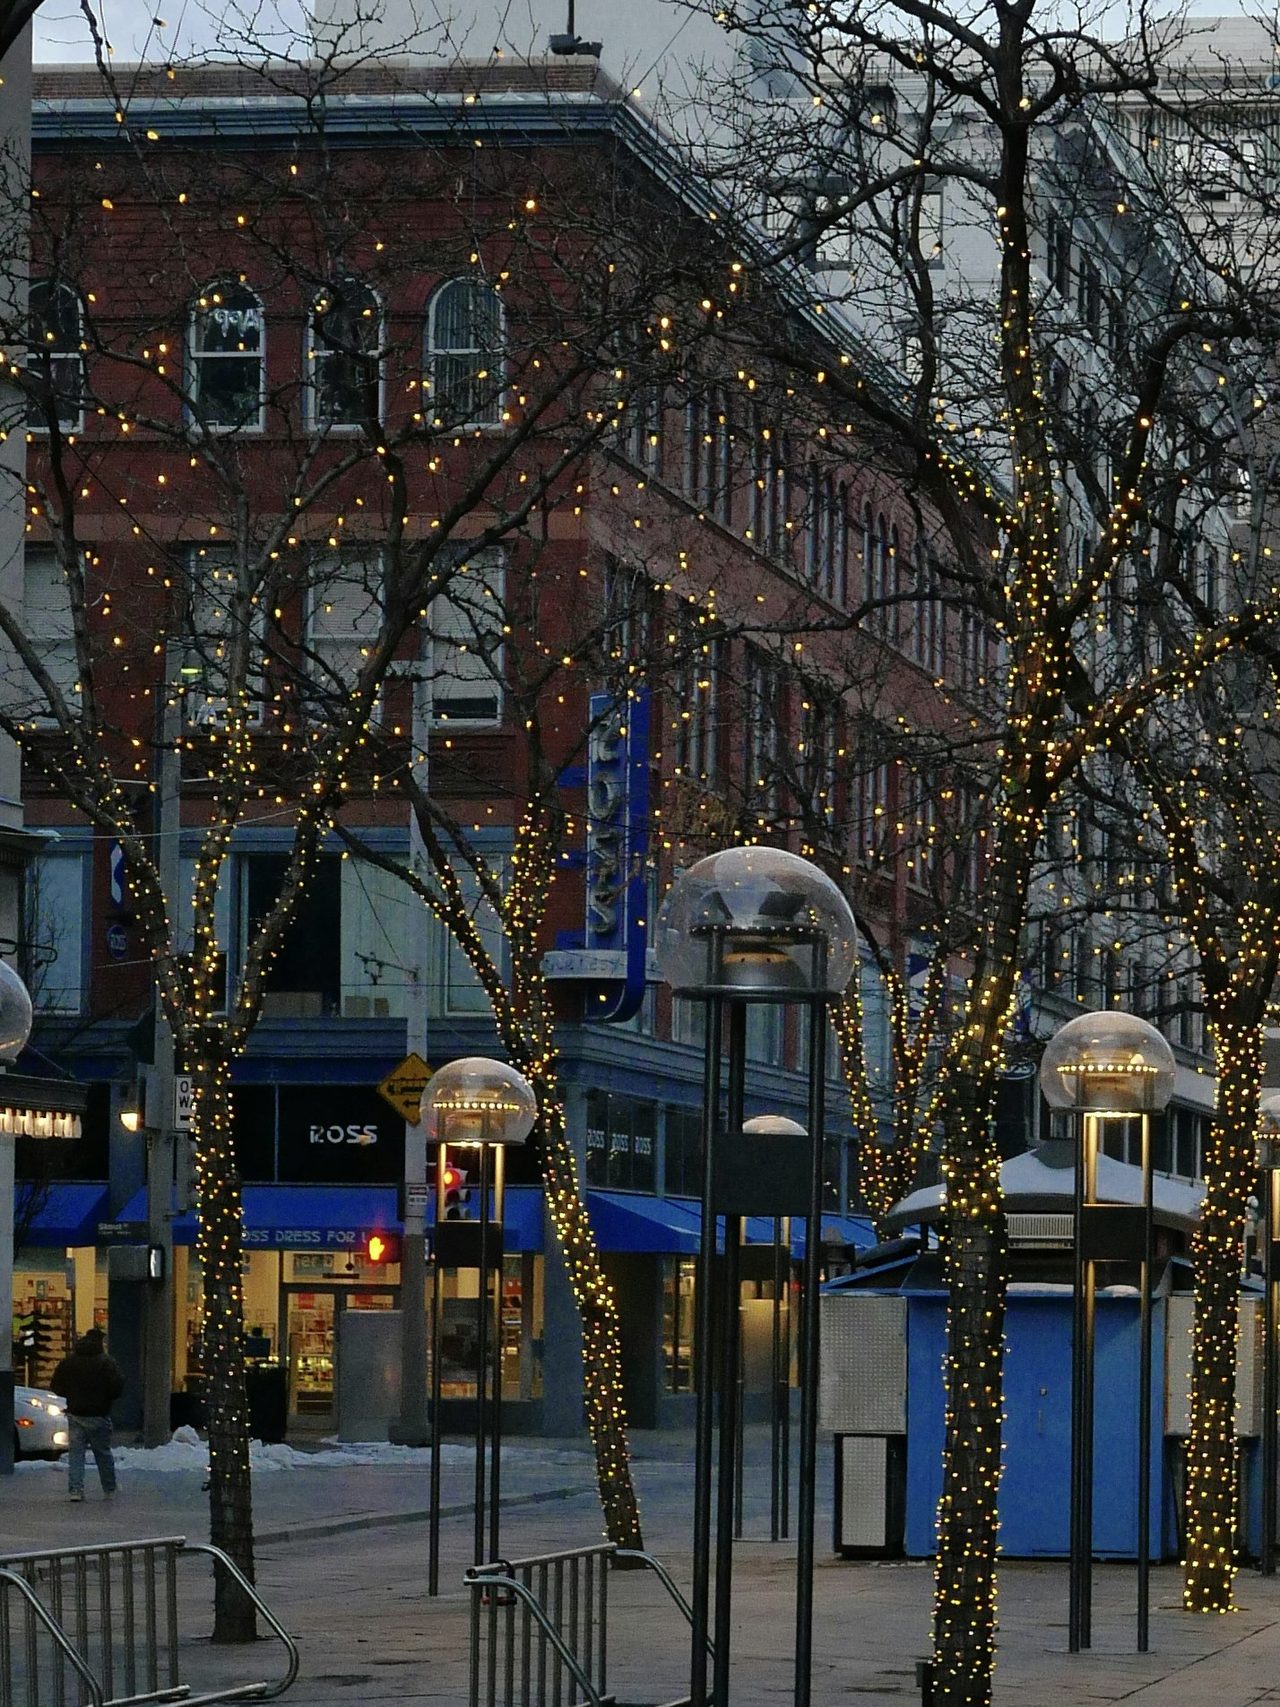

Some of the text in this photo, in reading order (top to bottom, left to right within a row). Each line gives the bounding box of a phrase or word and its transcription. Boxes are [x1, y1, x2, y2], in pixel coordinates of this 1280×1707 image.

[310, 1125, 378, 1144] ROSS
[241, 1230, 268, 1242] OSS
[275, 1231, 321, 1242] DRESS
[327, 1231, 356, 1243] FOR
